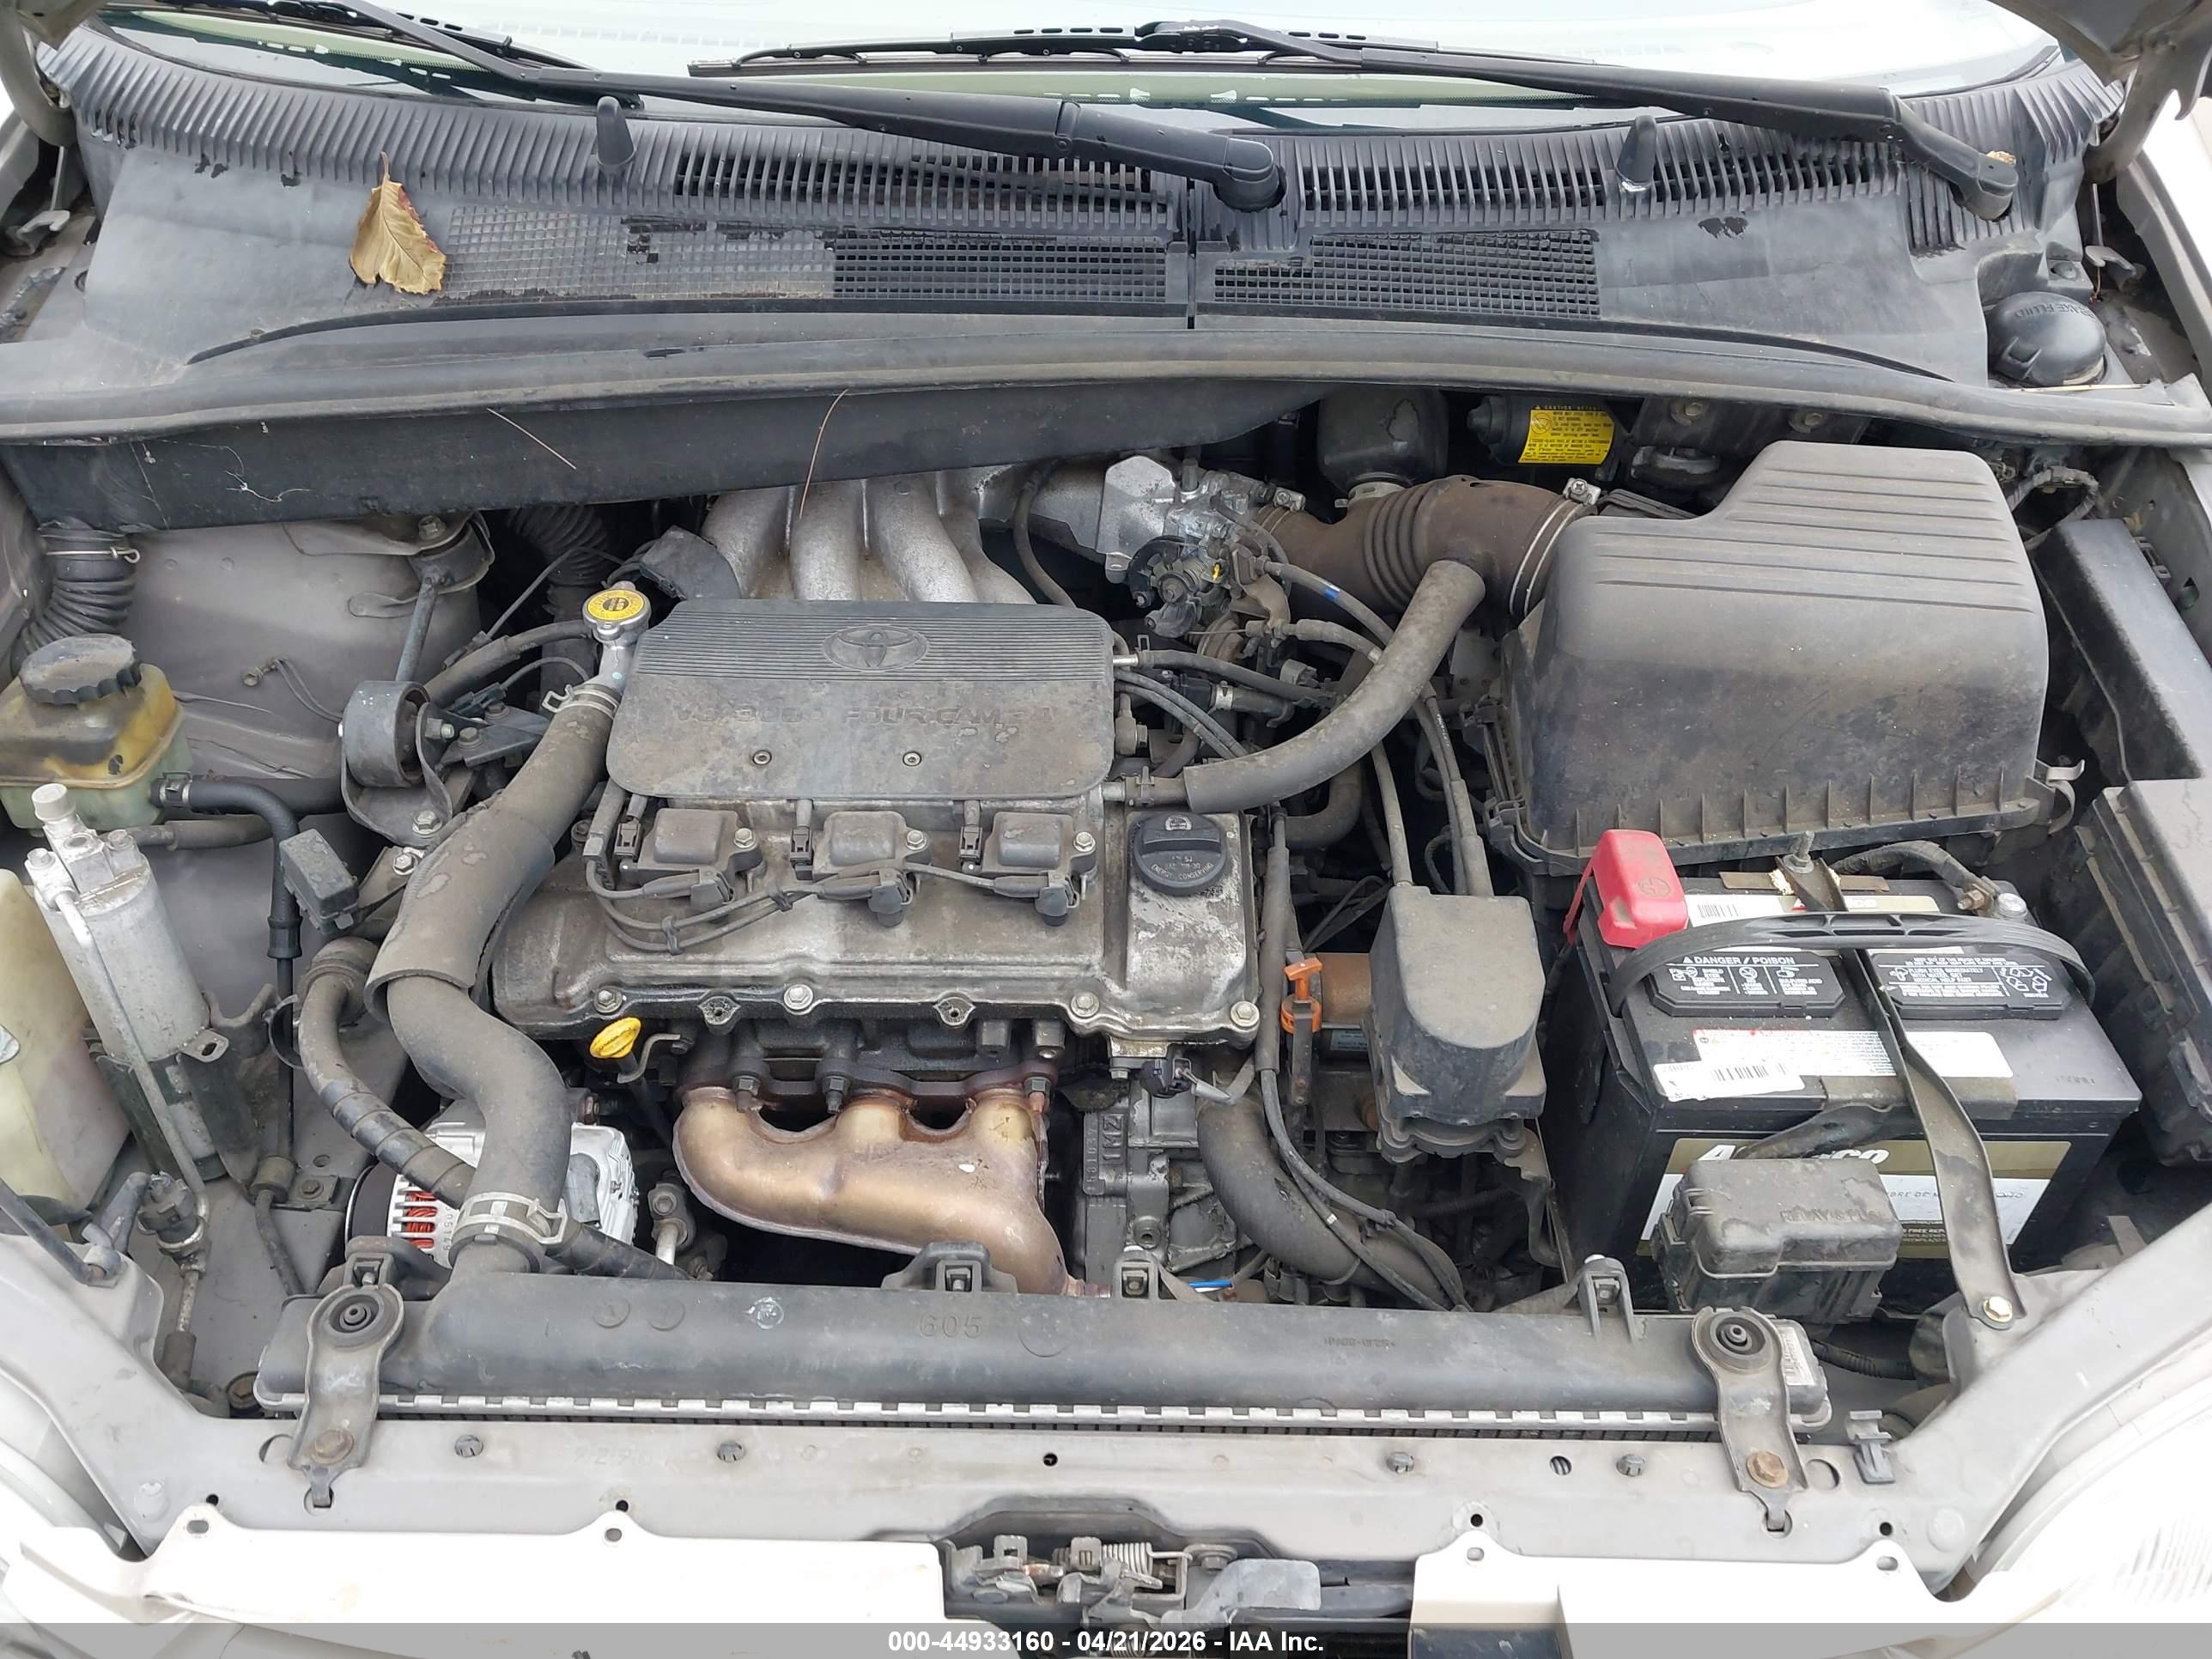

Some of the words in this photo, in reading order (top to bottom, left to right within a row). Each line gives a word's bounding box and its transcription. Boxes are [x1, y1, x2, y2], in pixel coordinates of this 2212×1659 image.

[1693, 956, 1741, 964] DANGER
[1103, 1115, 1121, 1160] 1MZ
[919, 1315, 983, 1338] 605
